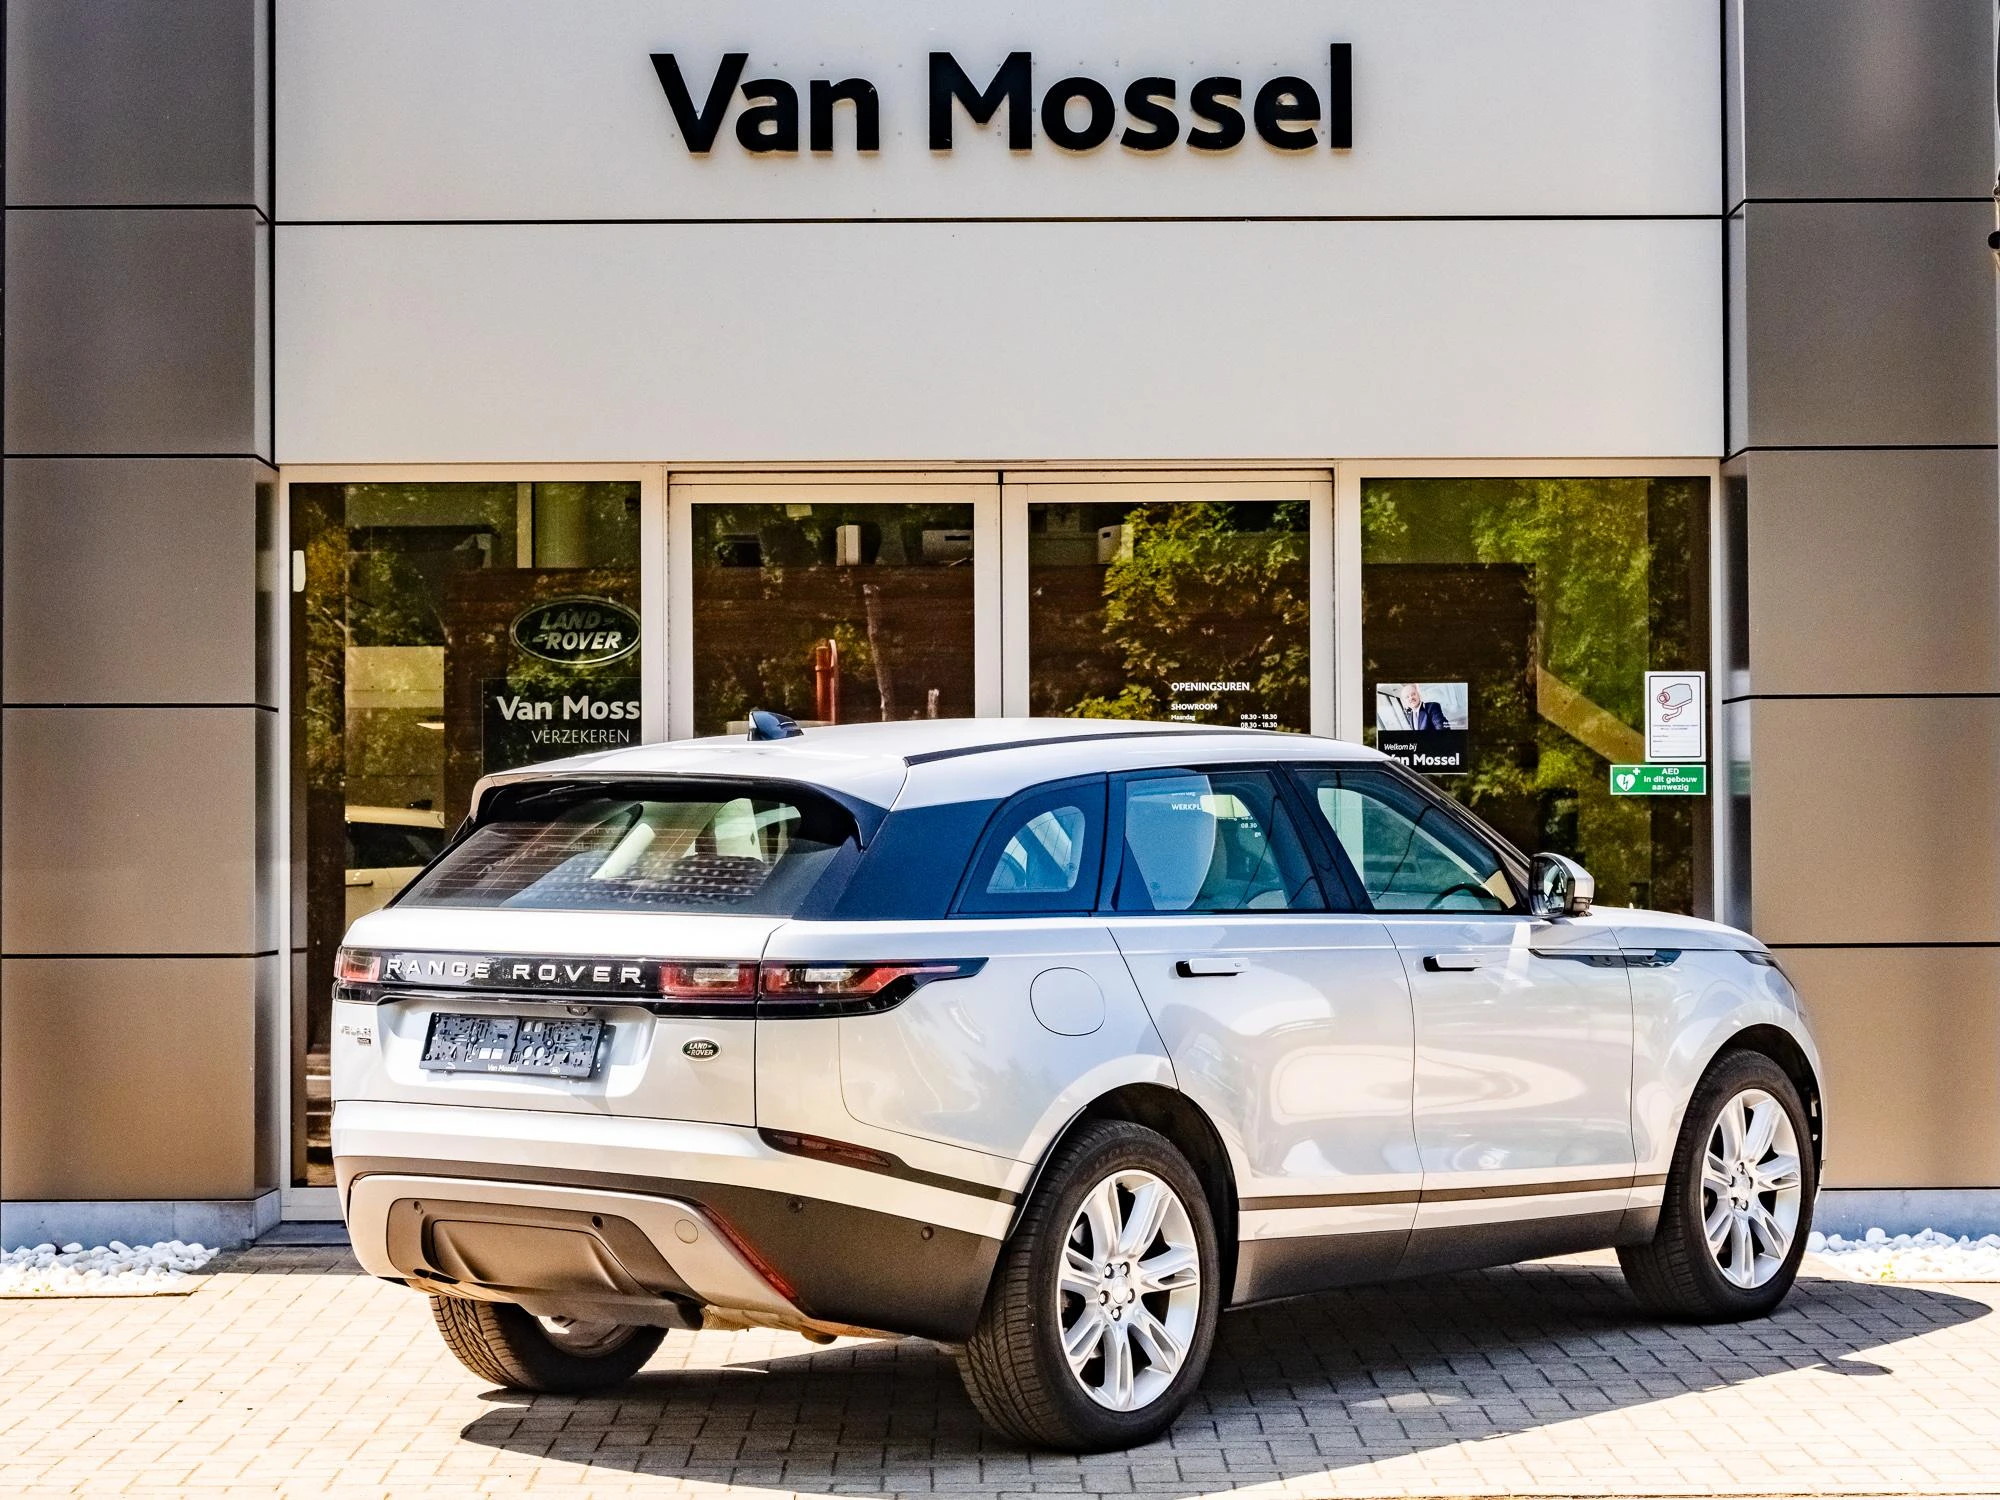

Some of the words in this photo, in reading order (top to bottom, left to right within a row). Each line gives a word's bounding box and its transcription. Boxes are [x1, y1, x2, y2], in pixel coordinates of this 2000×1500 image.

[649, 52, 880, 153] Van
[928, 43, 1353, 151] Mossel
[540, 611, 600, 630] LAND
[545, 631, 622, 650] ROVER
[1171, 682, 1250, 691] OPENINGSUREN
[496, 695, 552, 721] Van
[562, 695, 641, 720] Moss
[1171, 703, 1218, 711] SHOWROOM
[531, 729, 630, 744] VERZEKEREN
[1409, 743, 1417, 752] bij
[1413, 752, 1460, 766] Mossel
[1665, 776, 1698, 784] gebouw
[1652, 784, 1689, 792] aanwezig
[386, 958, 491, 980] RANGE
[512, 964, 641, 984] ROVER
[689, 1042, 708, 1050] LAND
